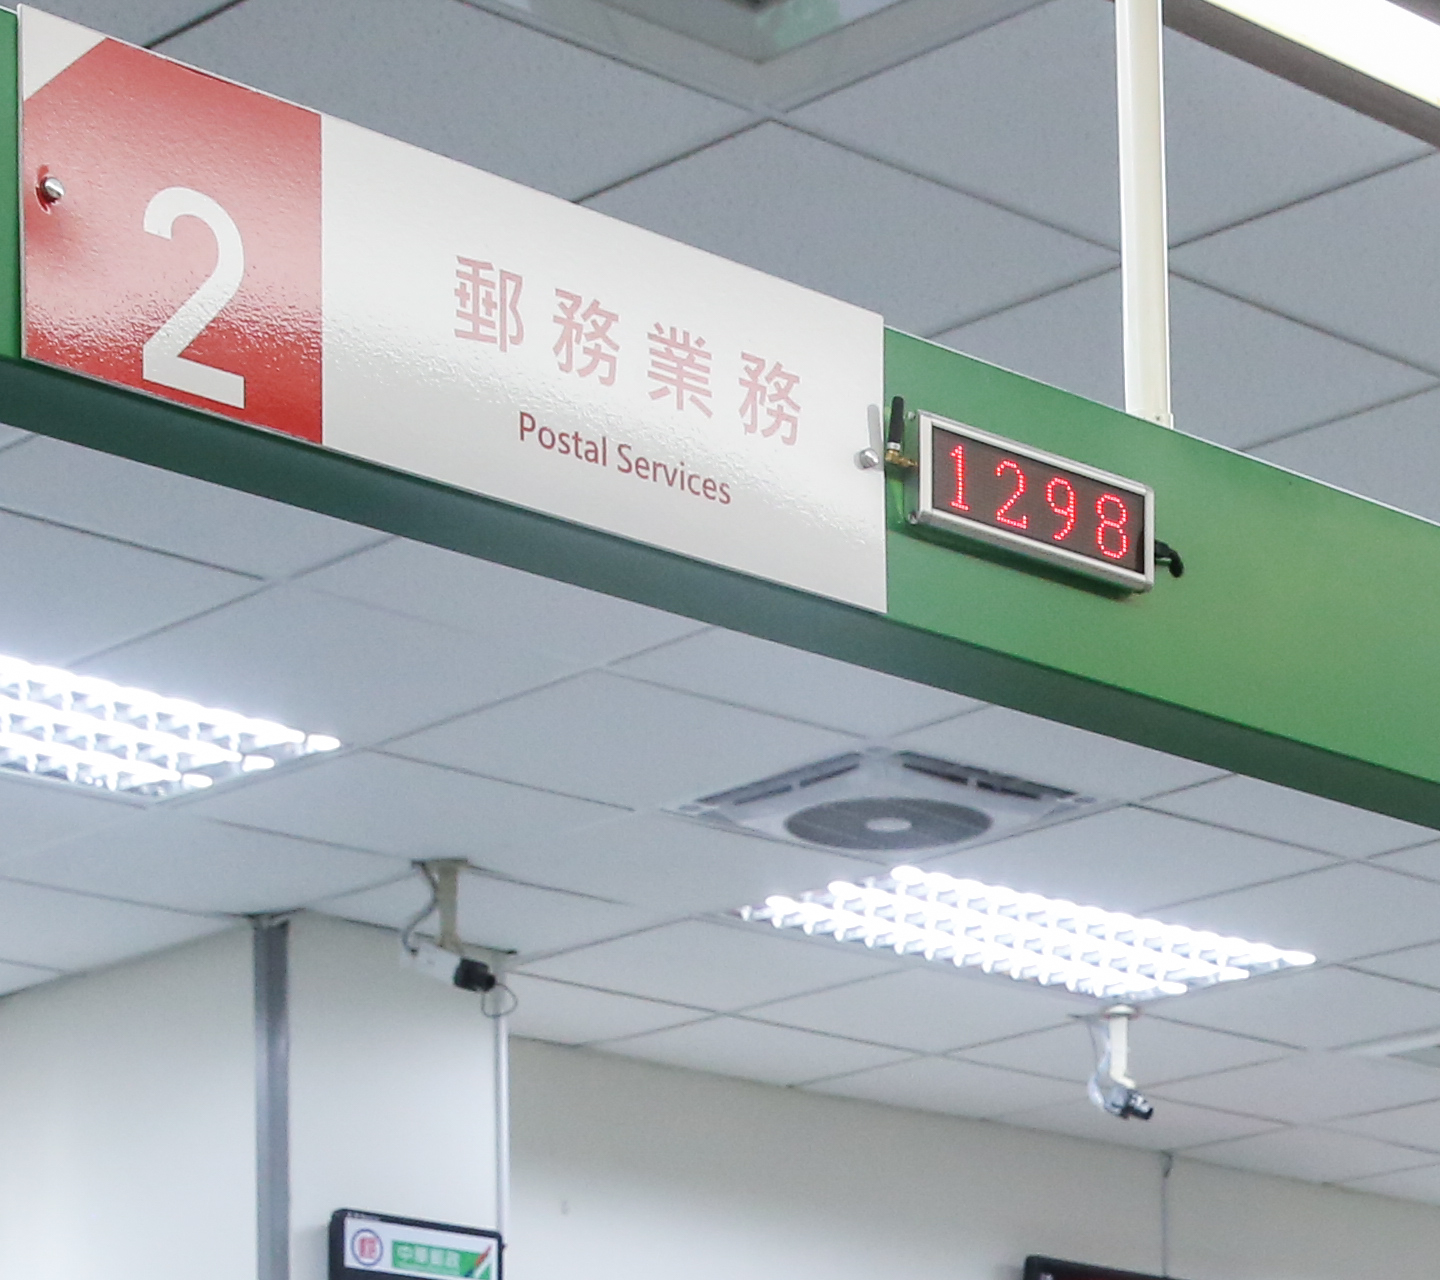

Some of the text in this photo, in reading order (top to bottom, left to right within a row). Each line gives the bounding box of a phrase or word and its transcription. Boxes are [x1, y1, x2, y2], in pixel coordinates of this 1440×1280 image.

[140, 185, 246, 410] 2
[452, 253, 804, 448] 郵務業務
[517, 410, 733, 507] Postal Services
[946, 442, 1133, 562] 1298
